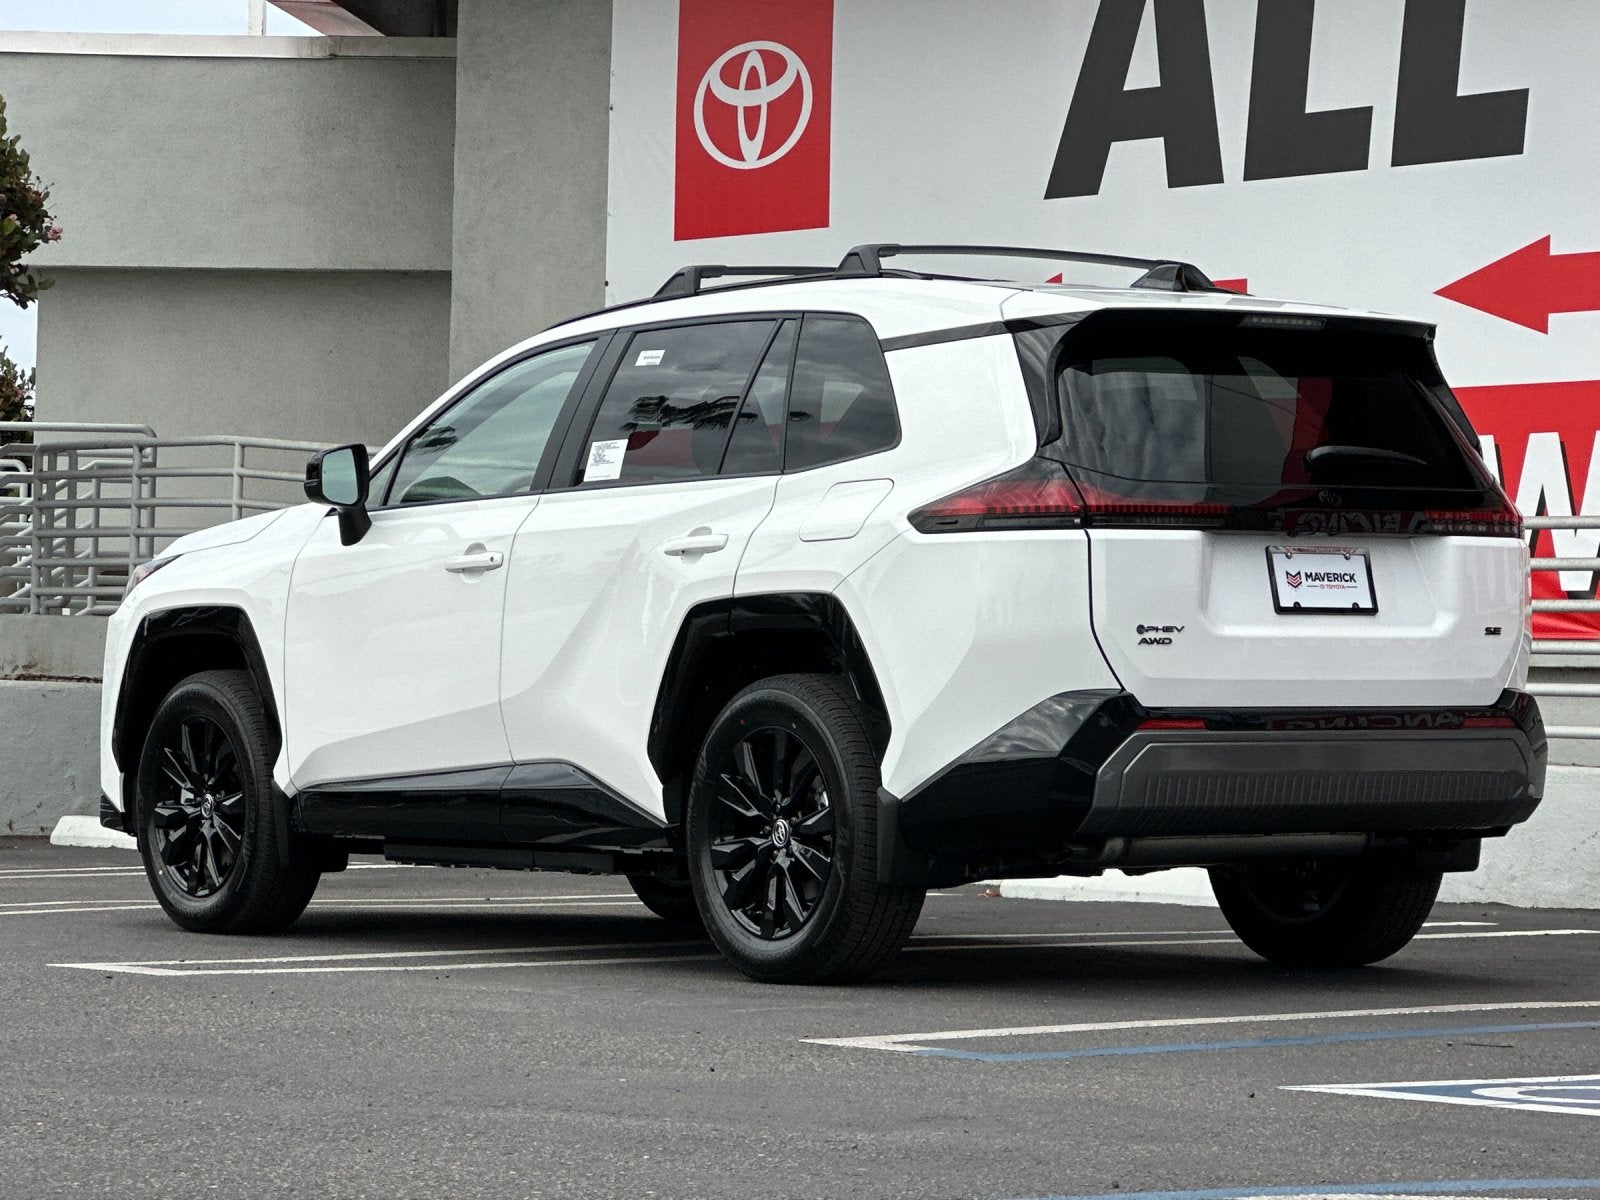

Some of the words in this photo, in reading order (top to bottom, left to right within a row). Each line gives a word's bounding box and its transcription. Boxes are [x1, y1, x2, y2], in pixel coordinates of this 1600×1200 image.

[1043, 0, 1530, 200] ALL
[1304, 571, 1357, 583] MAVERICK
[1145, 625, 1185, 633] PHEV
[1484, 626, 1502, 636] SE
[1138, 637, 1173, 645] AWD
